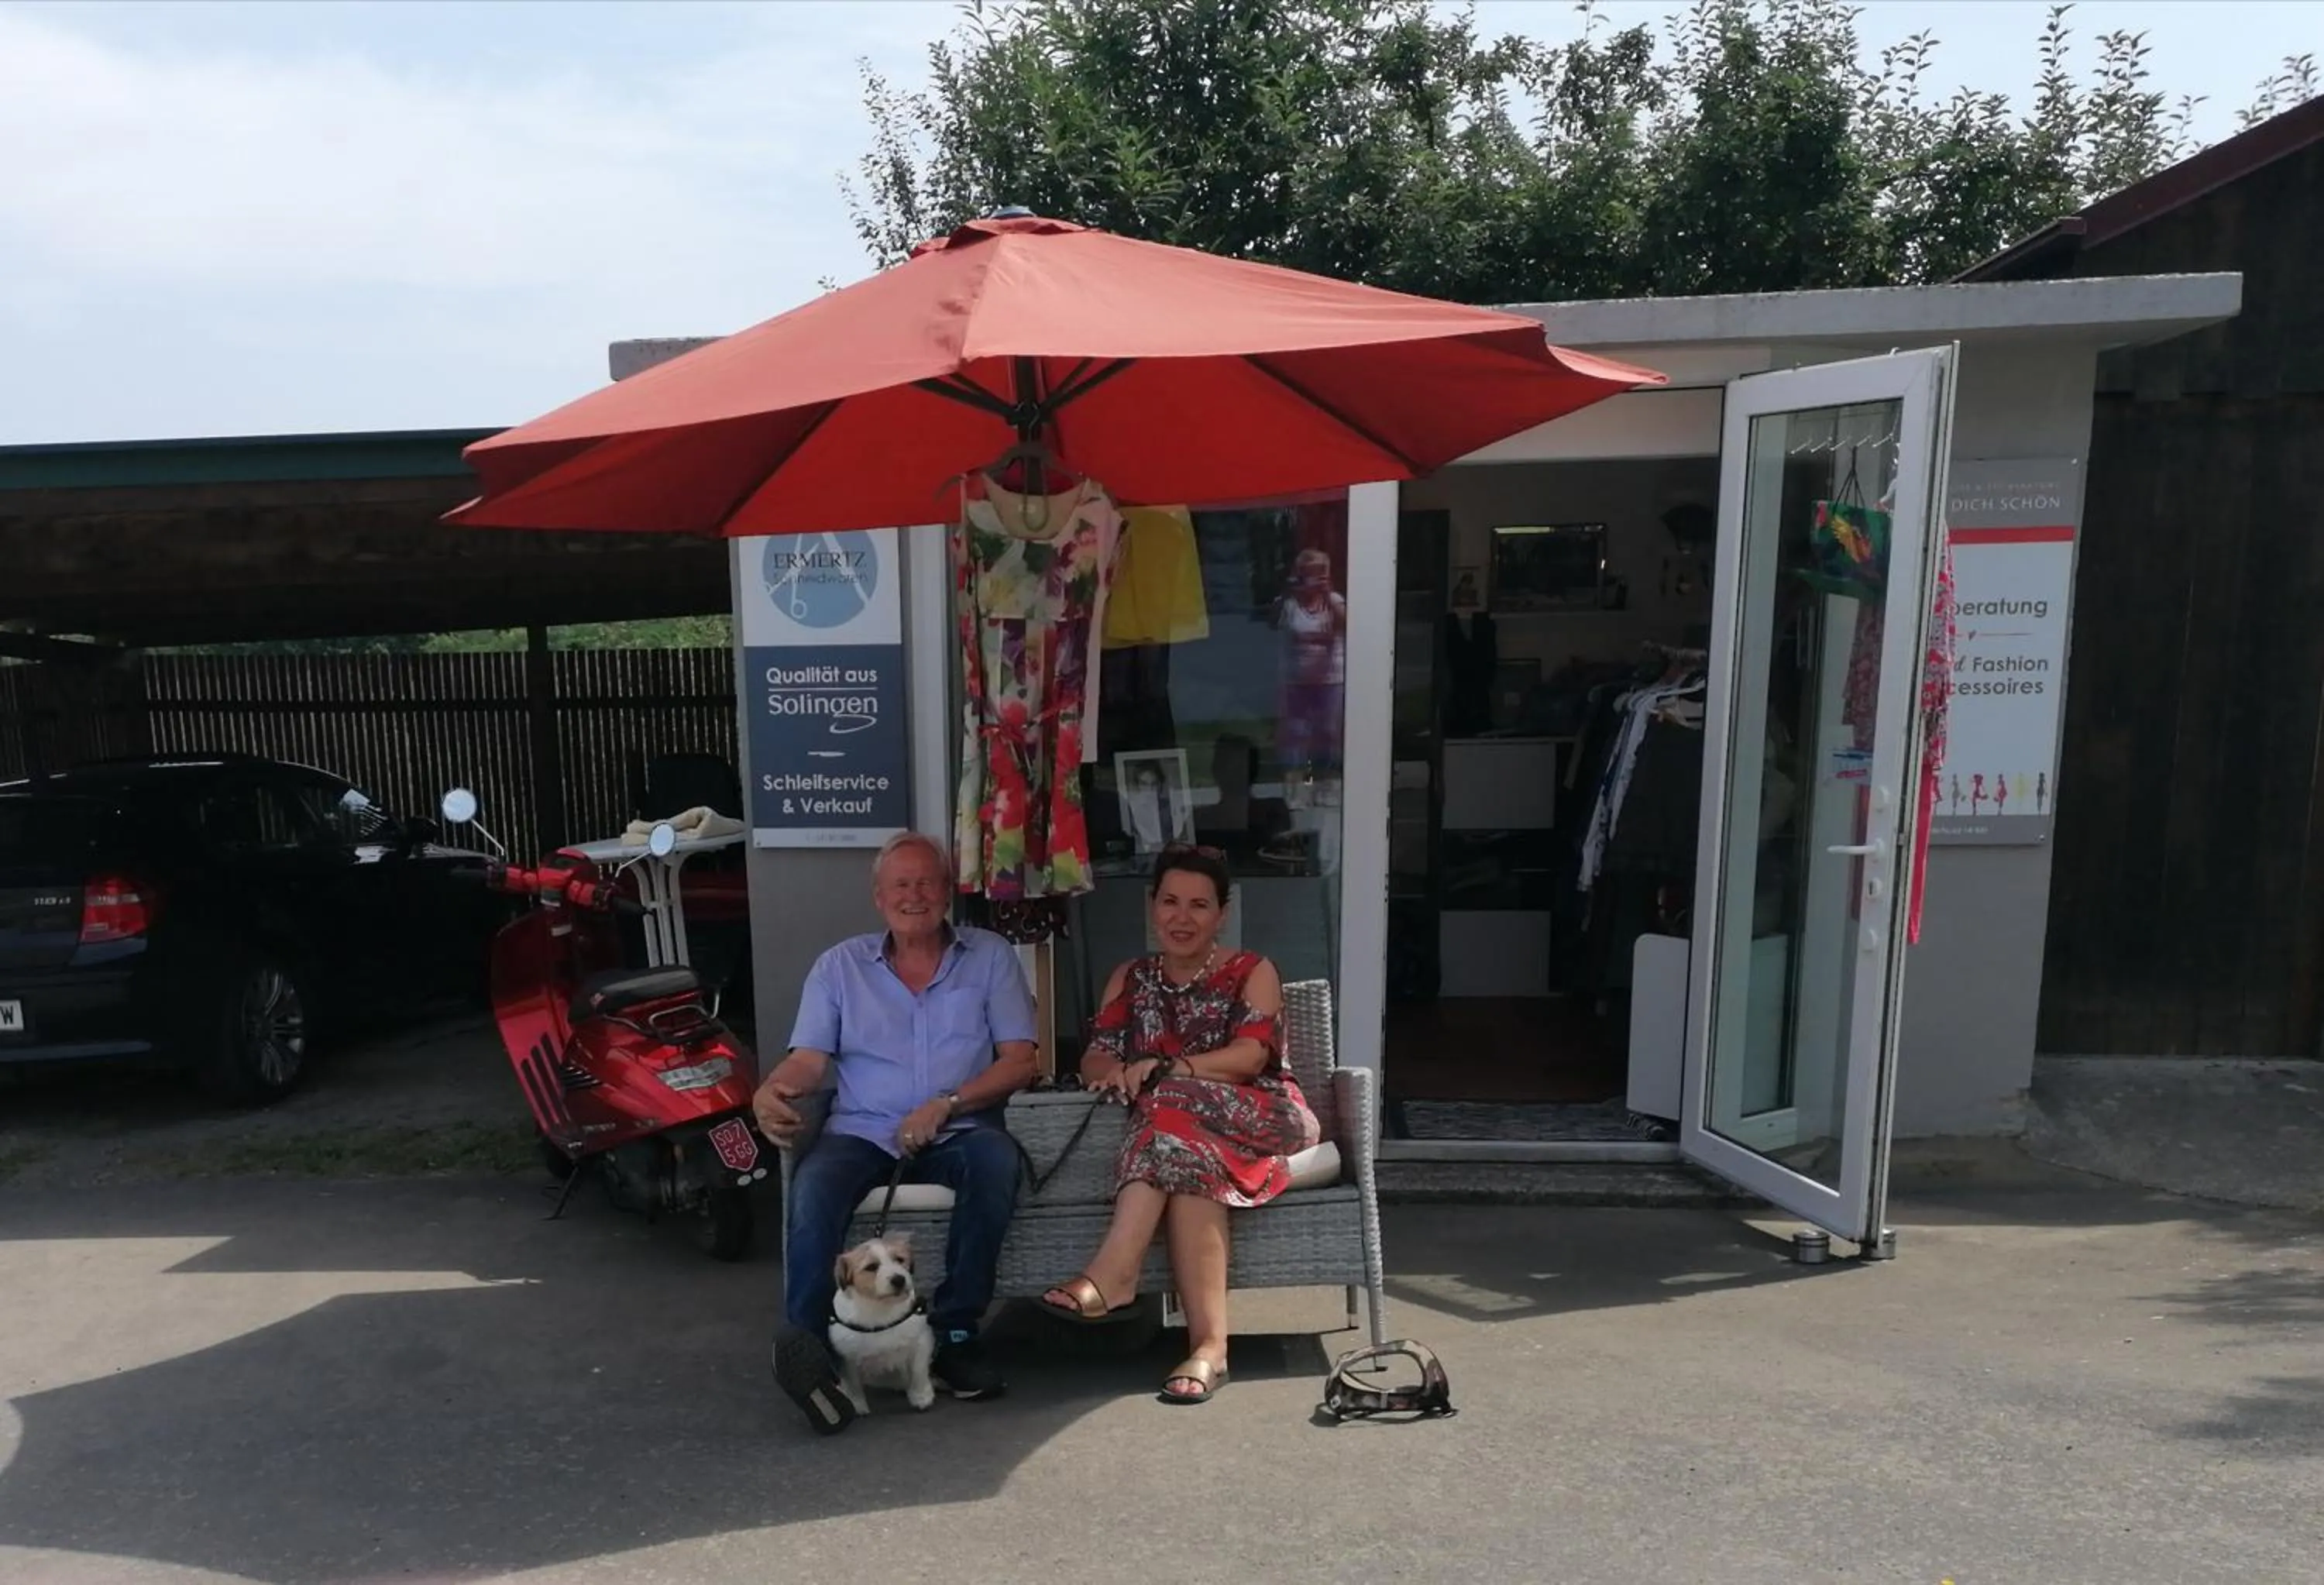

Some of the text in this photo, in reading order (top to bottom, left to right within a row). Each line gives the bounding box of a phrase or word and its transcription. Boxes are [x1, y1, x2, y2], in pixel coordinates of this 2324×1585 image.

[1972, 655, 2048, 672] Fashion
[766, 666, 878, 685] Qualität aus
[768, 693, 878, 733] Solingen
[763, 774, 889, 791] Schleifservice
[782, 796, 872, 813] & Verkauf
